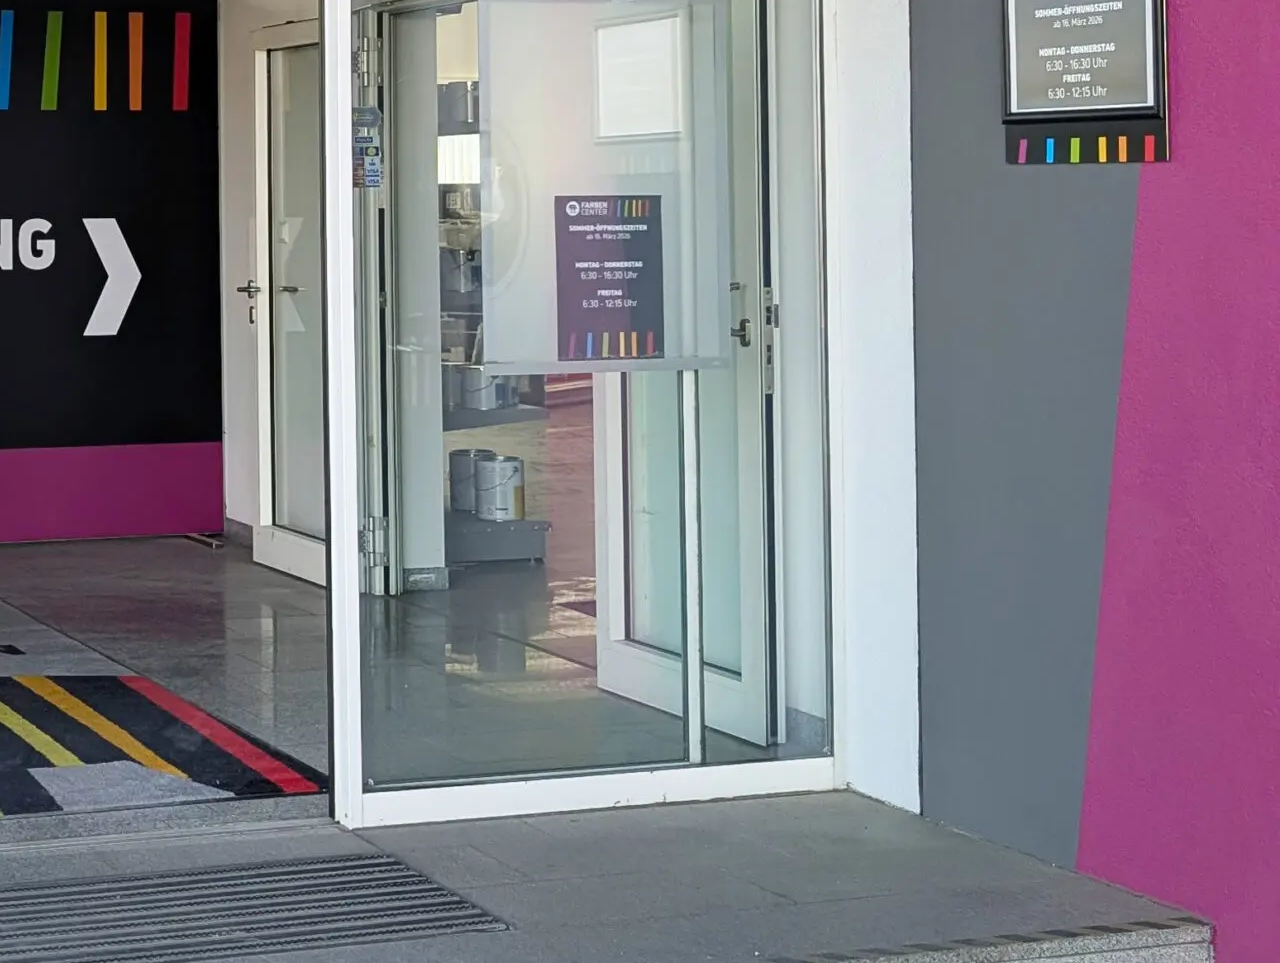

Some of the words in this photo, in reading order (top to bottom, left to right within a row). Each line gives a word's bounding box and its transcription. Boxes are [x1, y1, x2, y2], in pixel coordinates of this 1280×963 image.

[1071, 17, 1087, 27] März
[1039, 46, 1066, 57] MONTAG
[1070, 42, 1115, 55] DONNERSTAG
[1046, 59, 1063, 71] 6:30
[1070, 58, 1091, 70] 16:30
[1092, 57, 1108, 68] Uhr
[1063, 73, 1091, 83] FREITAG
[1048, 88, 1065, 99] 6:30
[1071, 86, 1091, 98] 12:15
[1092, 86, 1108, 97] Uhr
[581, 201, 608, 209] FARBEN
[581, 208, 608, 216] CENTER
[581, 271, 597, 279] 6:30
[624, 271, 638, 279] Uhr
[582, 299, 599, 308] 6:30
[605, 299, 622, 307] 12:15
[624, 299, 638, 307] Uhr
